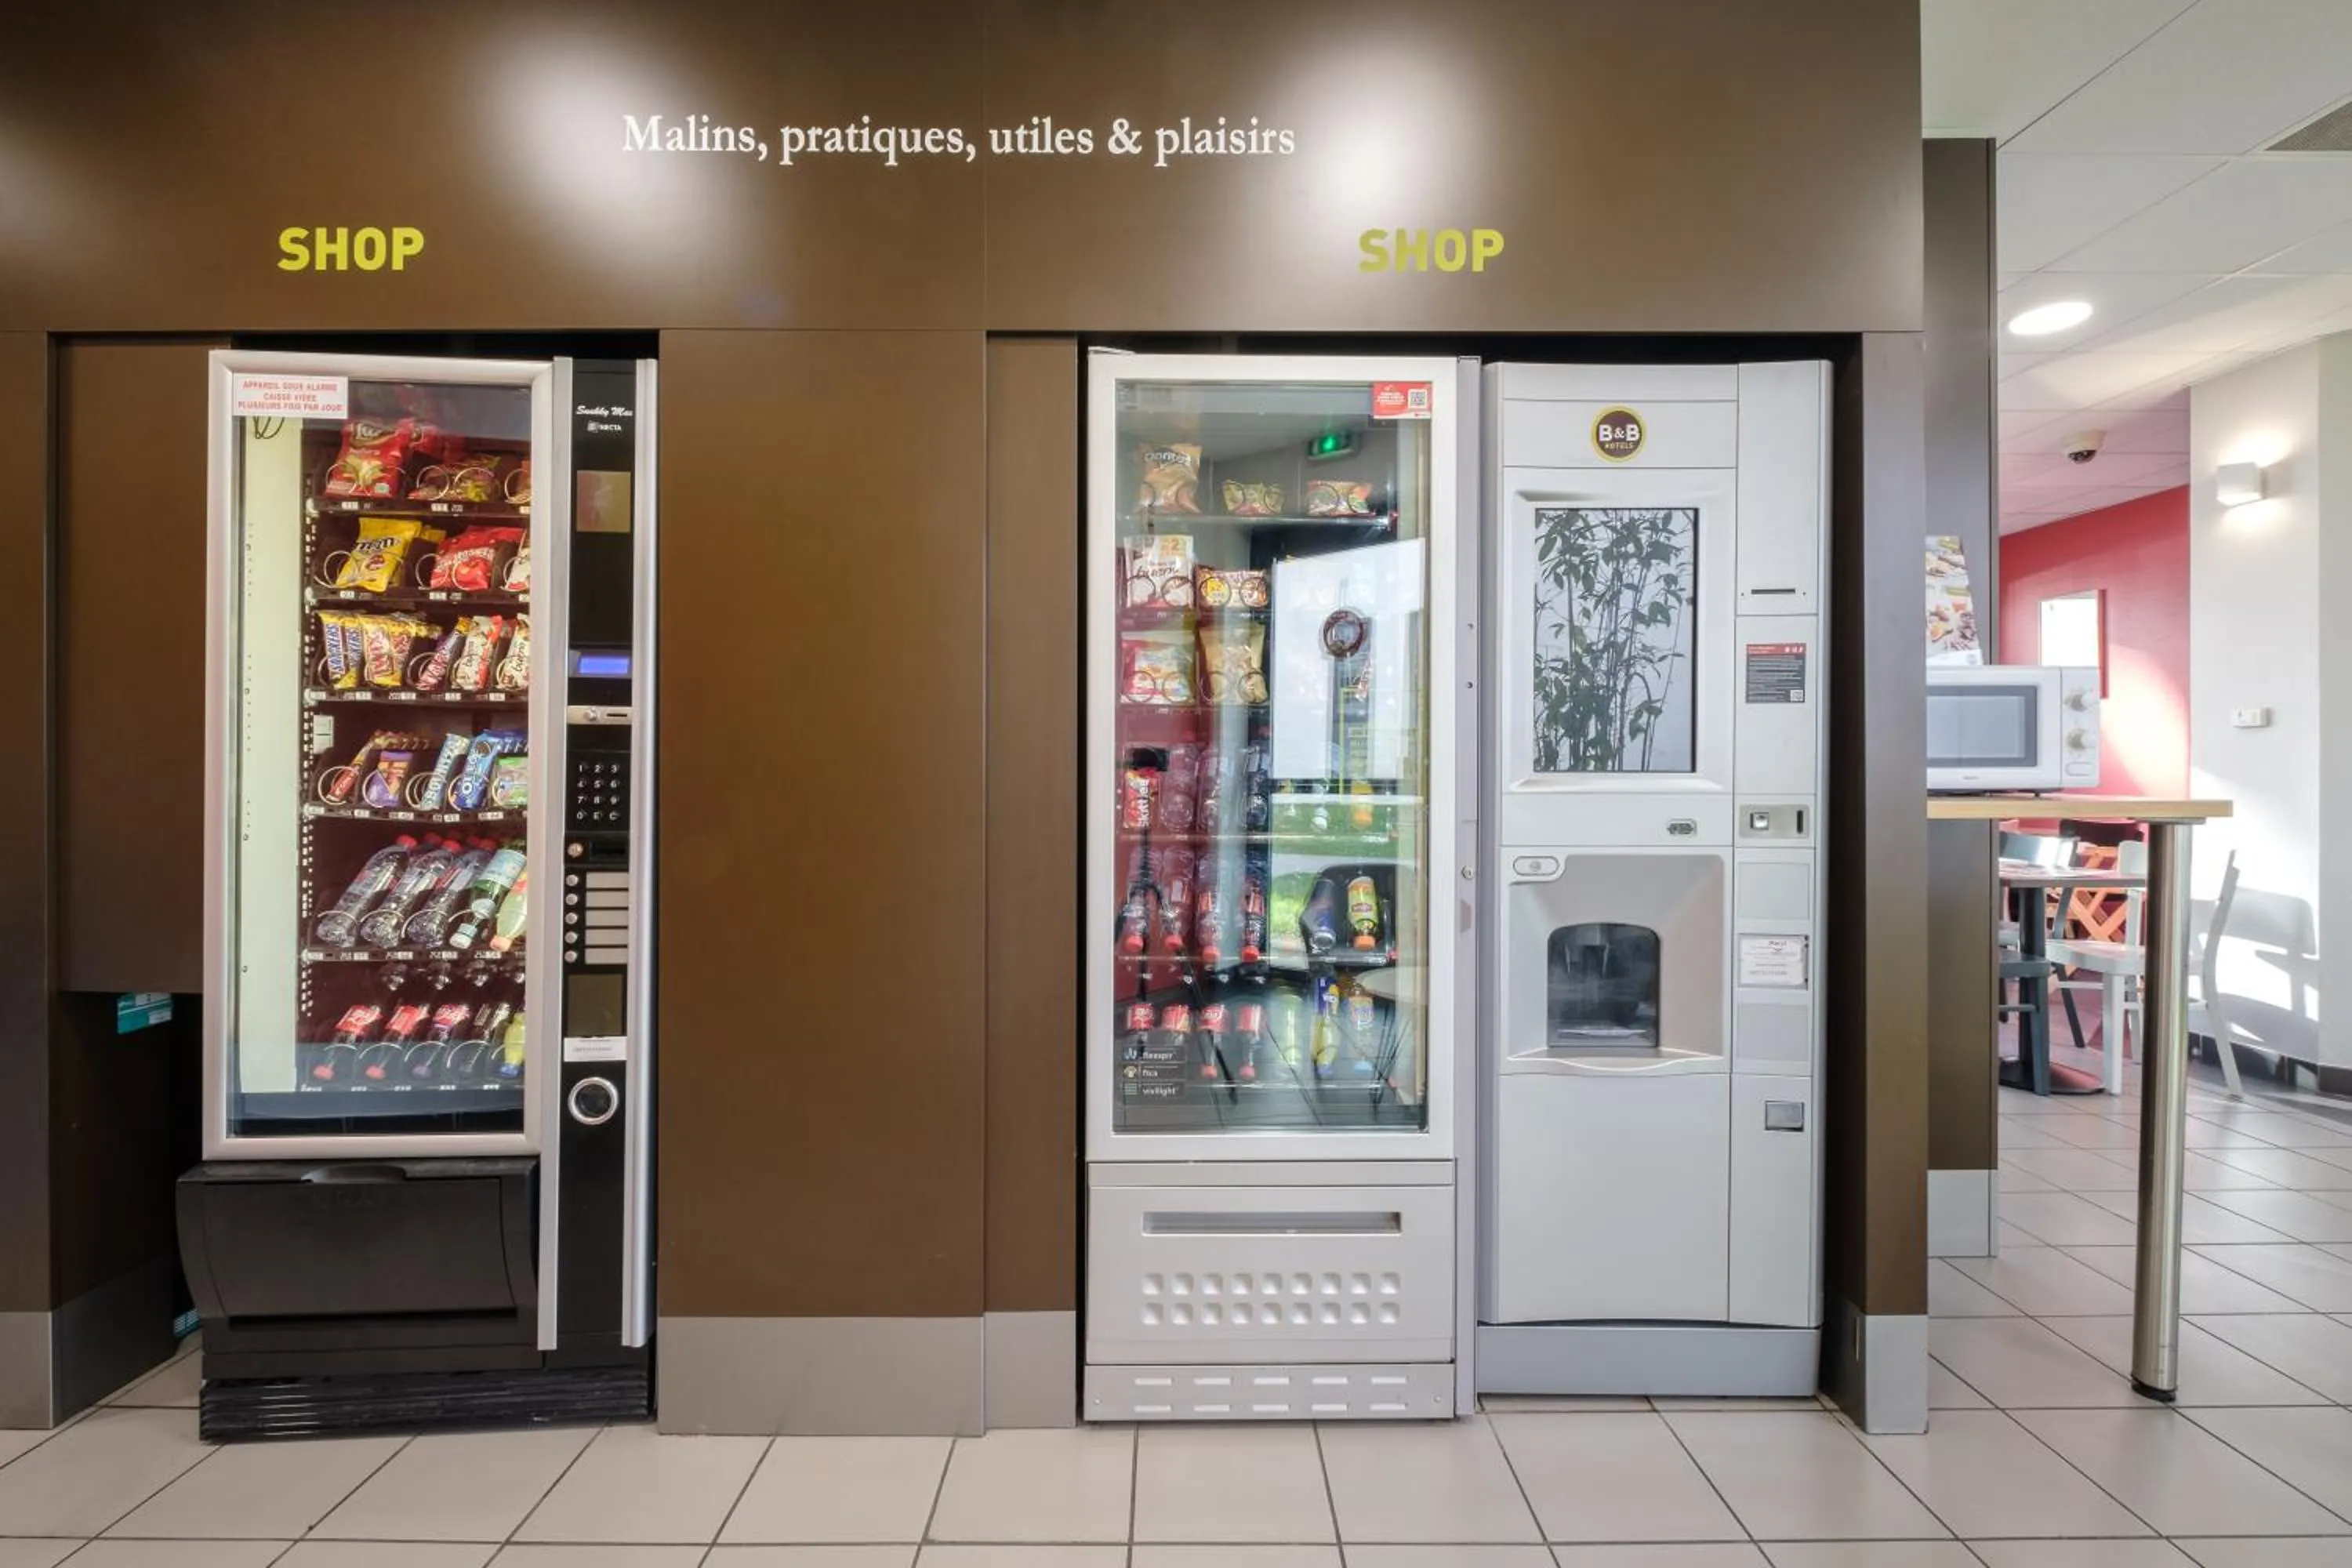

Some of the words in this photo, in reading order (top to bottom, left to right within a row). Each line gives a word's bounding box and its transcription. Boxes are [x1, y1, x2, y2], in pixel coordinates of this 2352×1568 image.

[622, 114, 768, 162] Malins,
[779, 114, 976, 165] pratiques,
[989, 116, 1094, 154] utiles
[1107, 118, 1142, 155] &
[1153, 117, 1295, 167] plaisirs
[277, 227, 424, 270] SHOP
[1359, 228, 1504, 272] SHOP
[1599, 424, 1640, 441] B&B
[594, 764, 601, 773] 2
